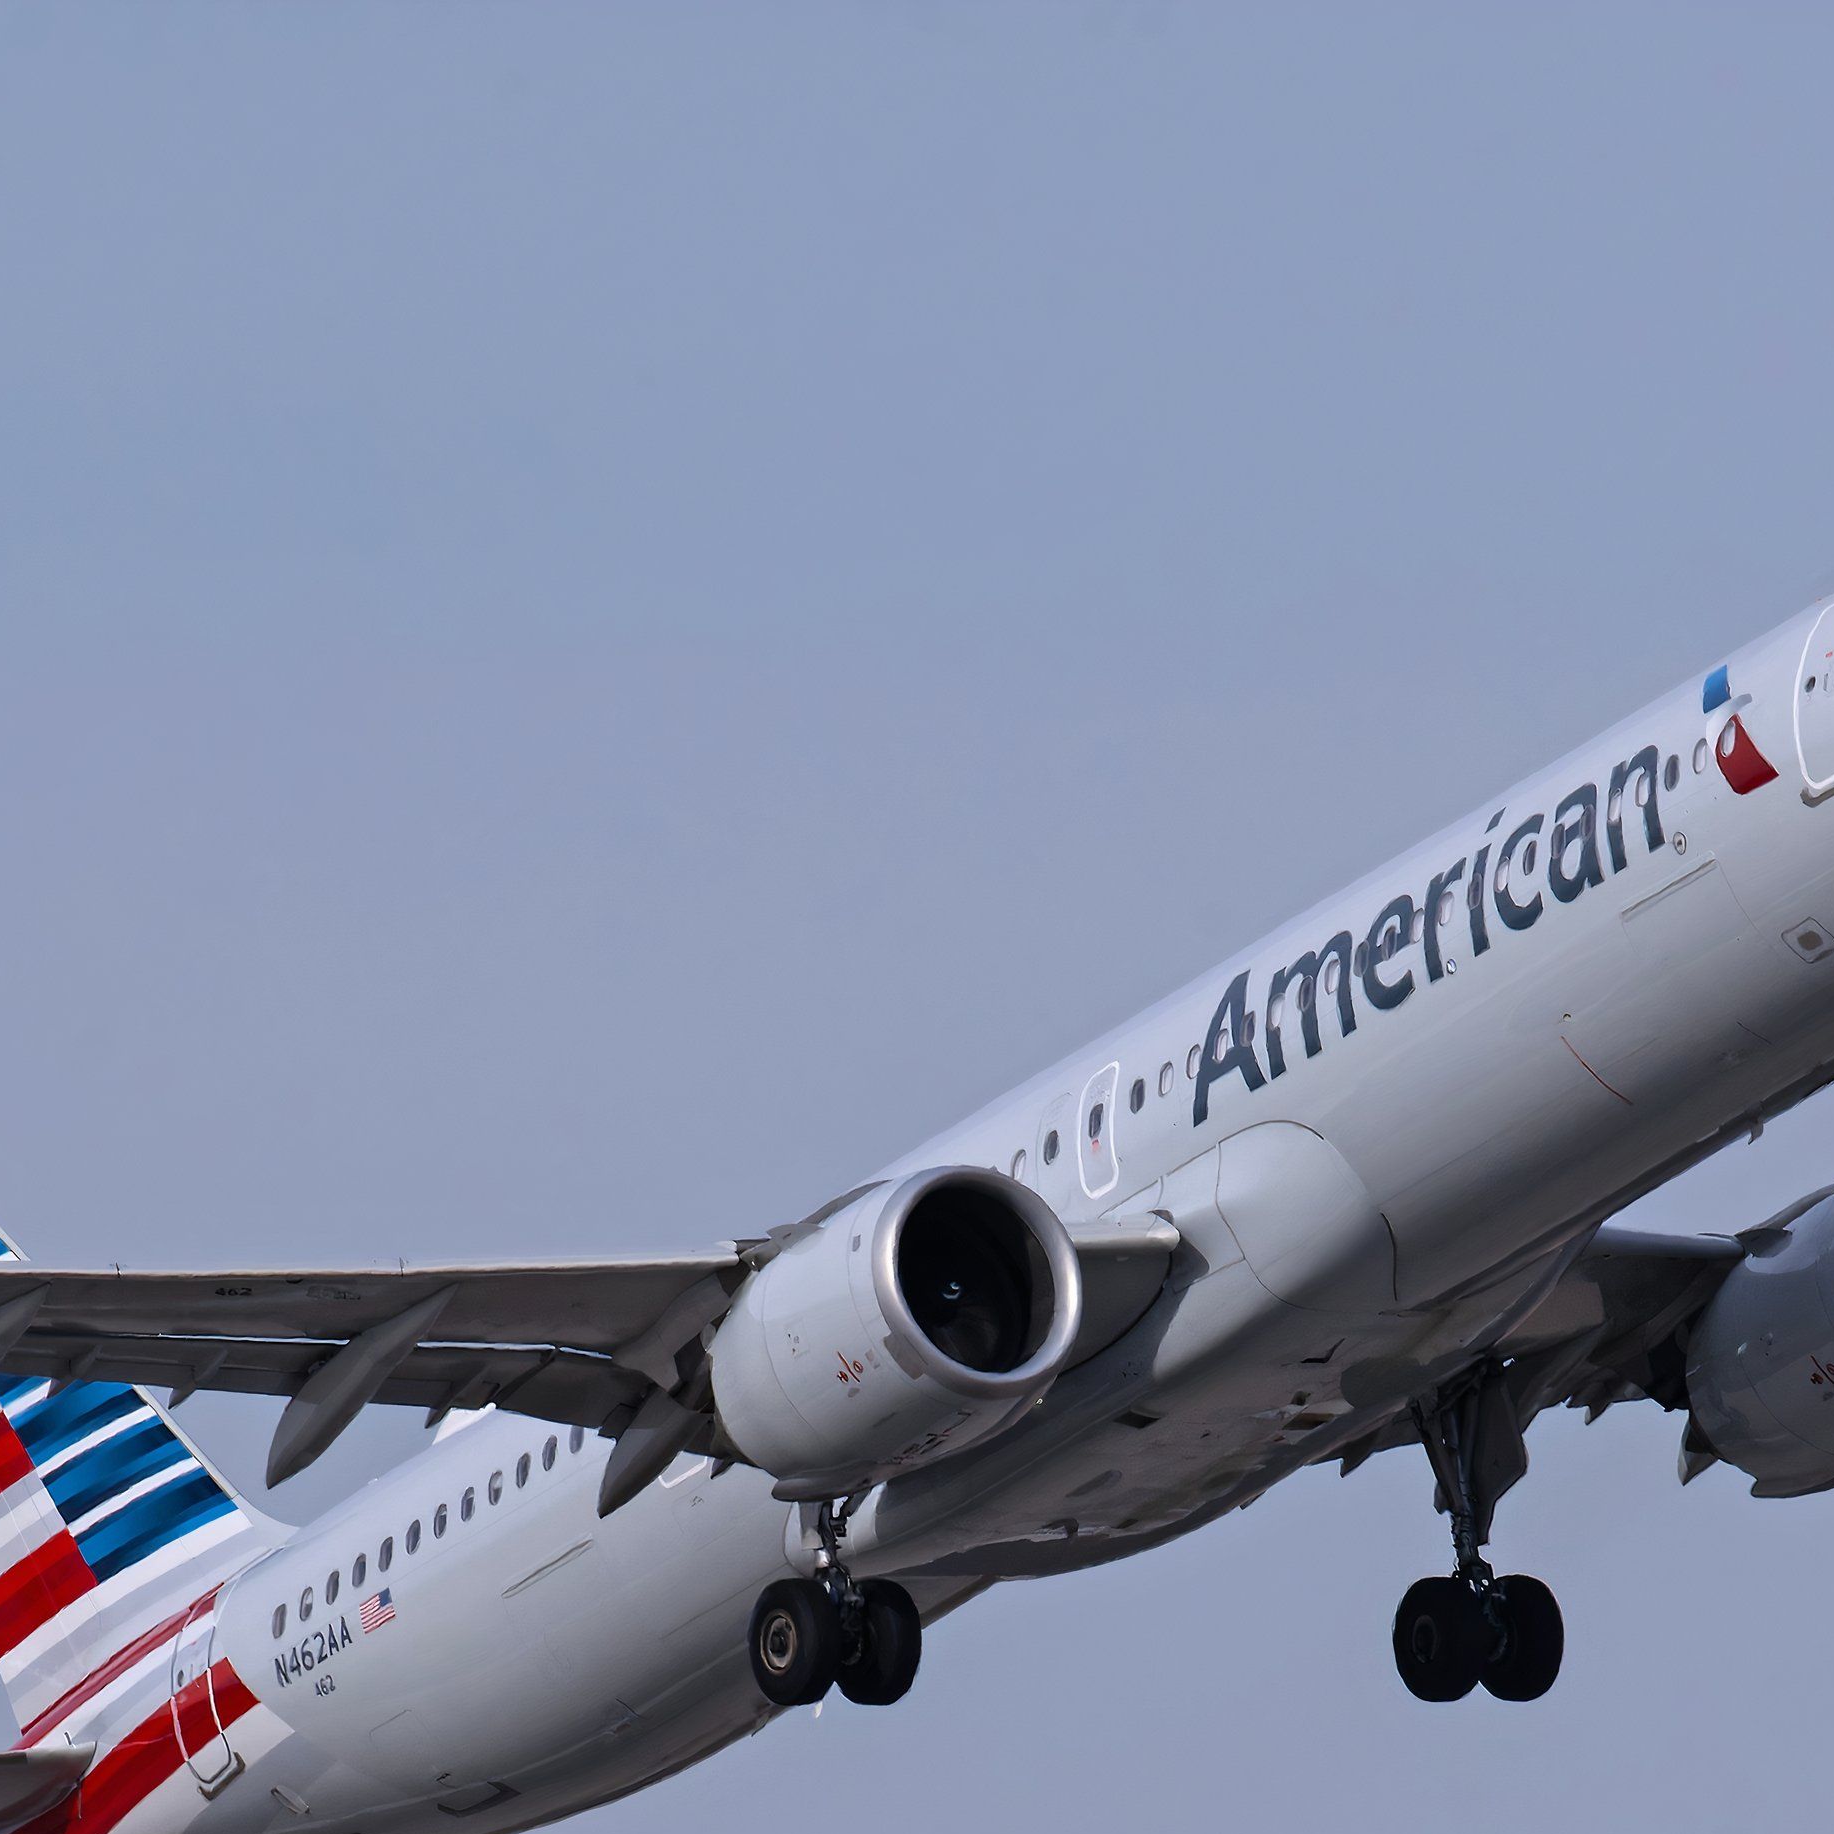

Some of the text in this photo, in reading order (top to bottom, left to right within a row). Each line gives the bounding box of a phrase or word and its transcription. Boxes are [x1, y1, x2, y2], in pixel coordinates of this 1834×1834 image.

[1193, 744, 1666, 1127] American
[274, 1616, 353, 1688] N462AA
[315, 1674, 336, 1697] 462
